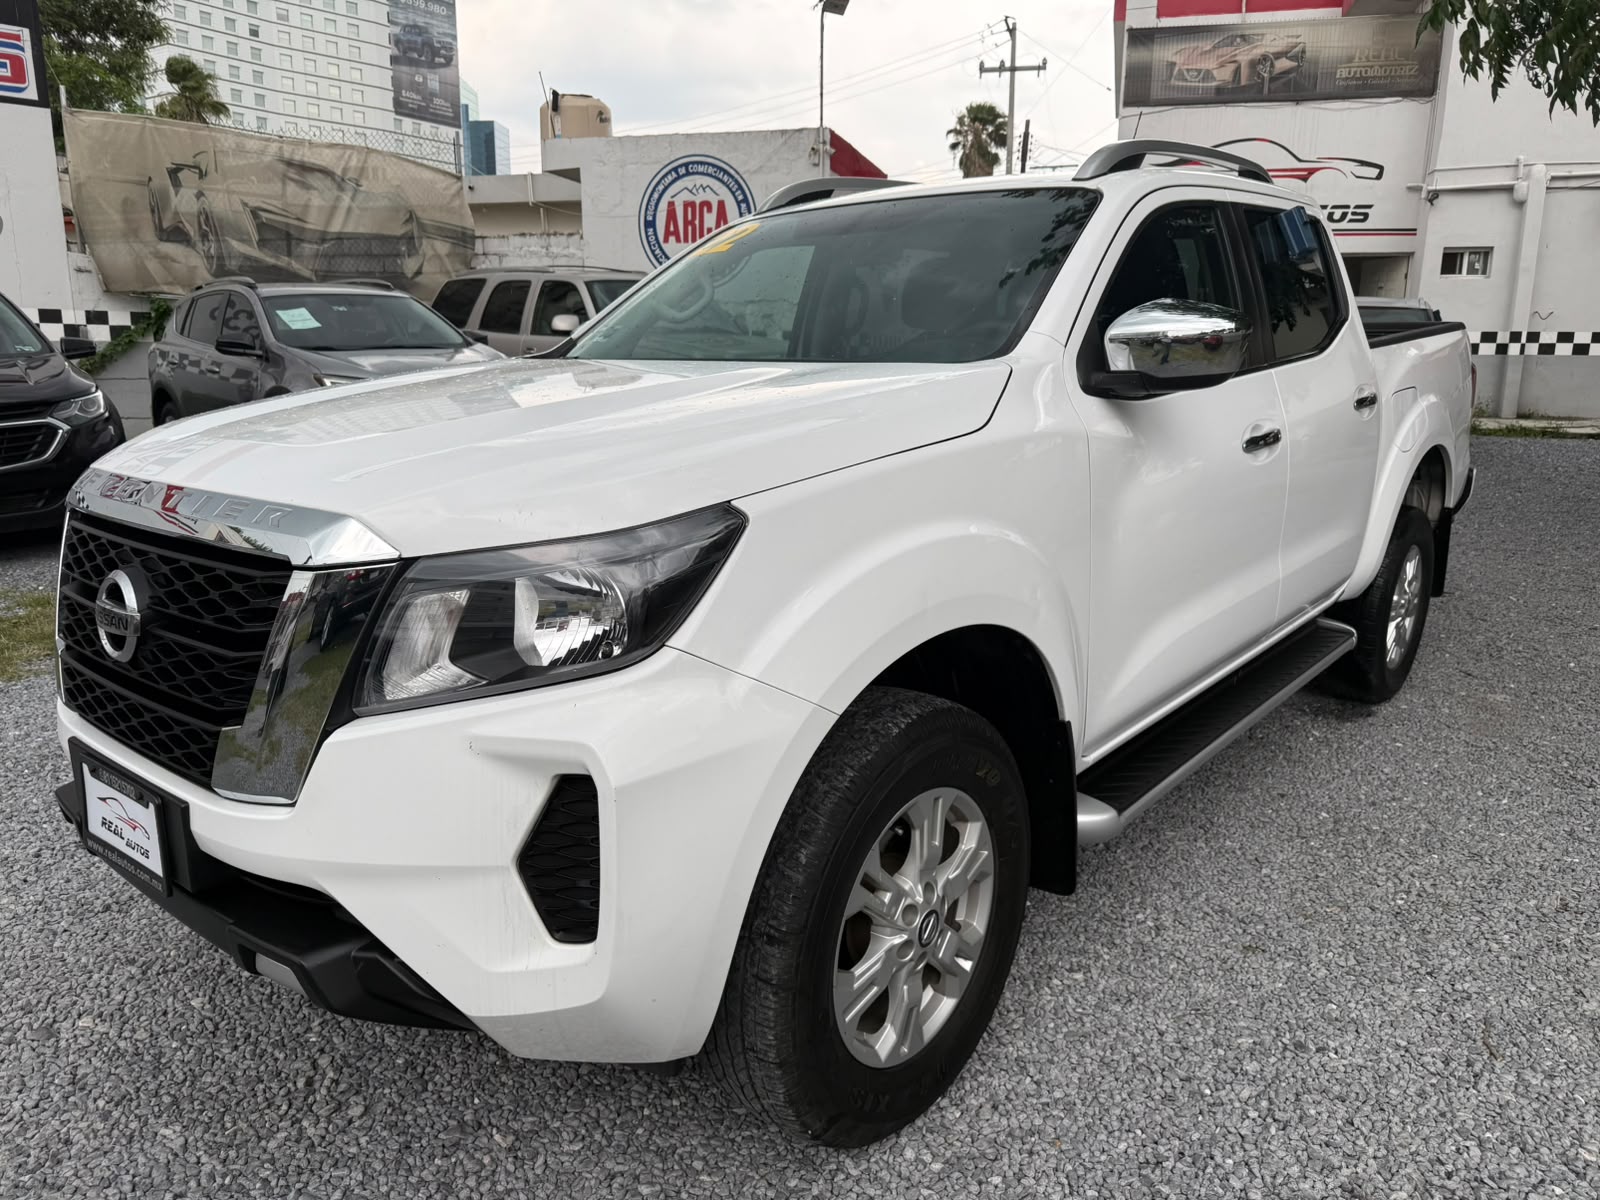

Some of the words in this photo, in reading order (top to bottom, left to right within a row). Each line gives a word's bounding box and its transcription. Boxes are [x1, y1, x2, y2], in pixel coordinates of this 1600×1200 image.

[1335, 64, 1419, 79] AUTOMOTRIZ
[678, 166, 688, 174] DE
[688, 164, 738, 191] COMERCIANTES
[735, 190, 744, 201] EN
[663, 199, 729, 244] ARCA
[80, 471, 292, 529] FRONTIER
[101, 816, 125, 840] REAL
[125, 837, 150, 860] AUTOS
